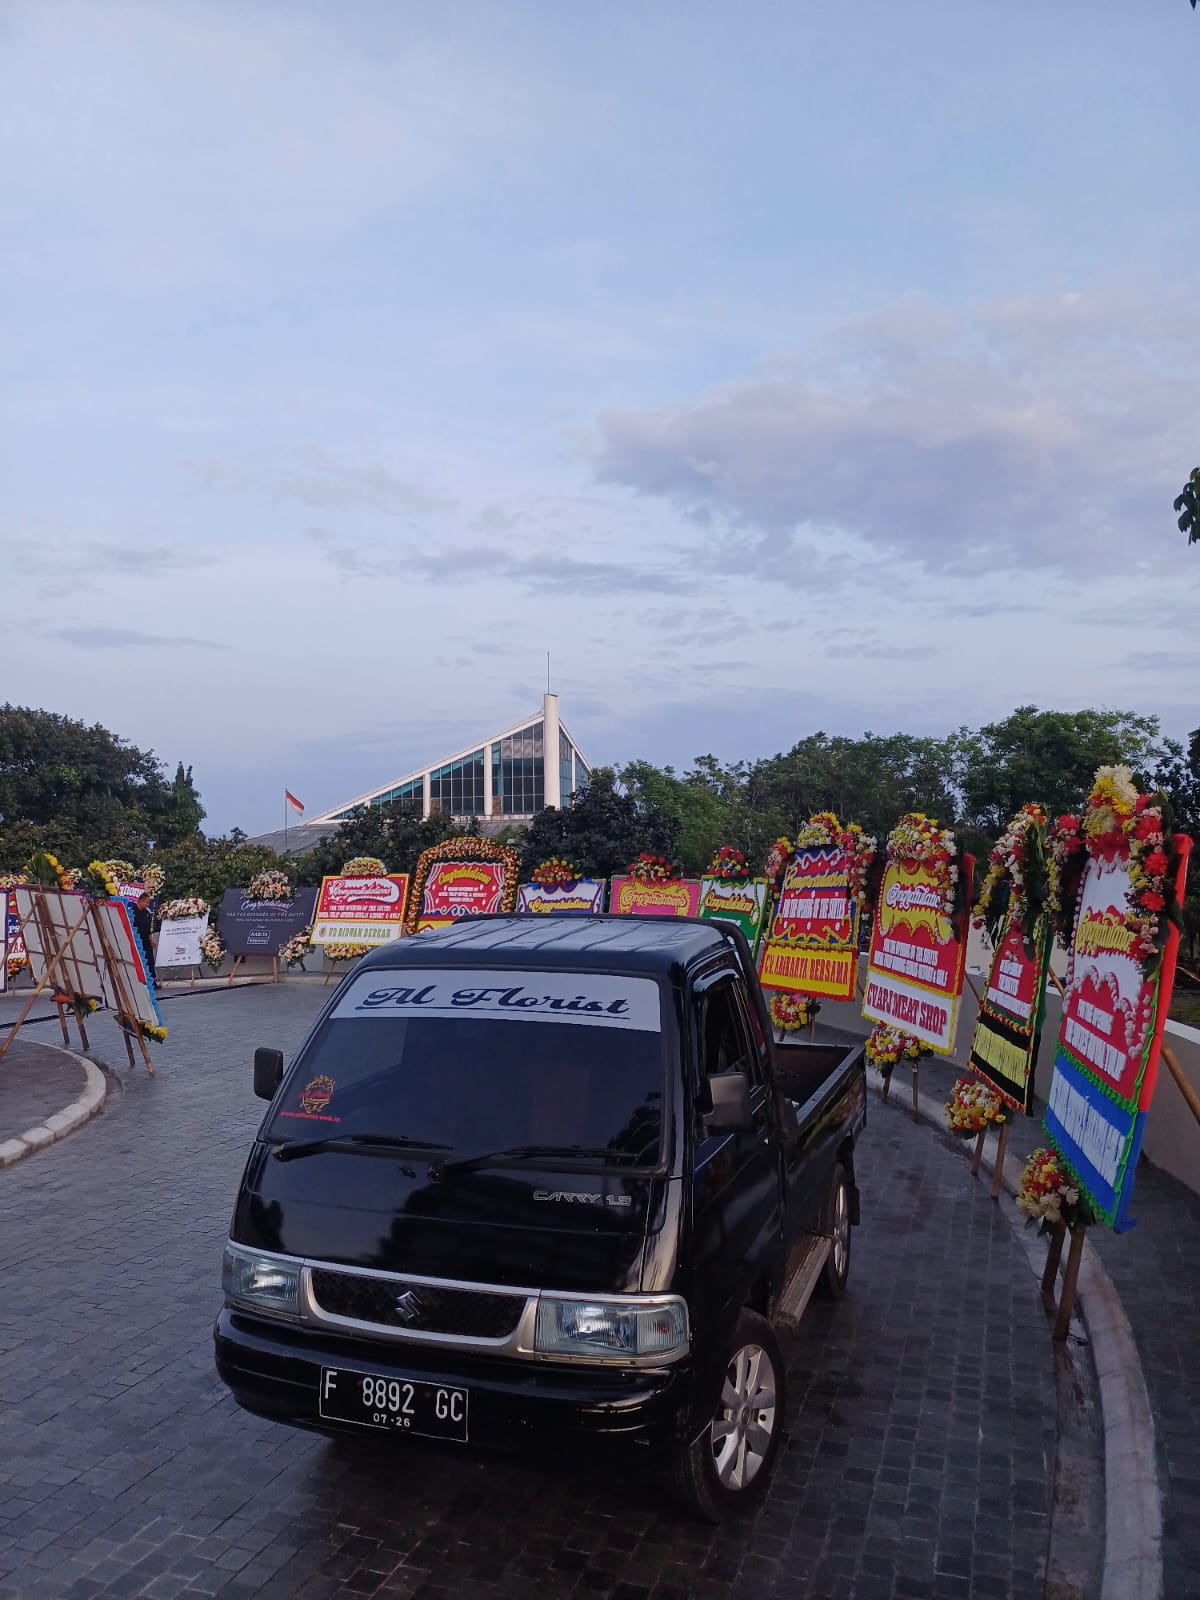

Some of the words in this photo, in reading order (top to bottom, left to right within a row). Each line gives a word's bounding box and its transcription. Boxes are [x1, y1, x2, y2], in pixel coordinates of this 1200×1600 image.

[809, 958, 848, 984] BERSAMA
[450, 986, 630, 1014] Florist
[892, 991, 919, 1025] MEAT
[919, 1000, 947, 1036] SHOP
[533, 1190, 602, 1204] CARRY
[324, 1370, 337, 1400] F
[362, 1377, 415, 1414] 8892
[435, 1389, 464, 1422] GC
